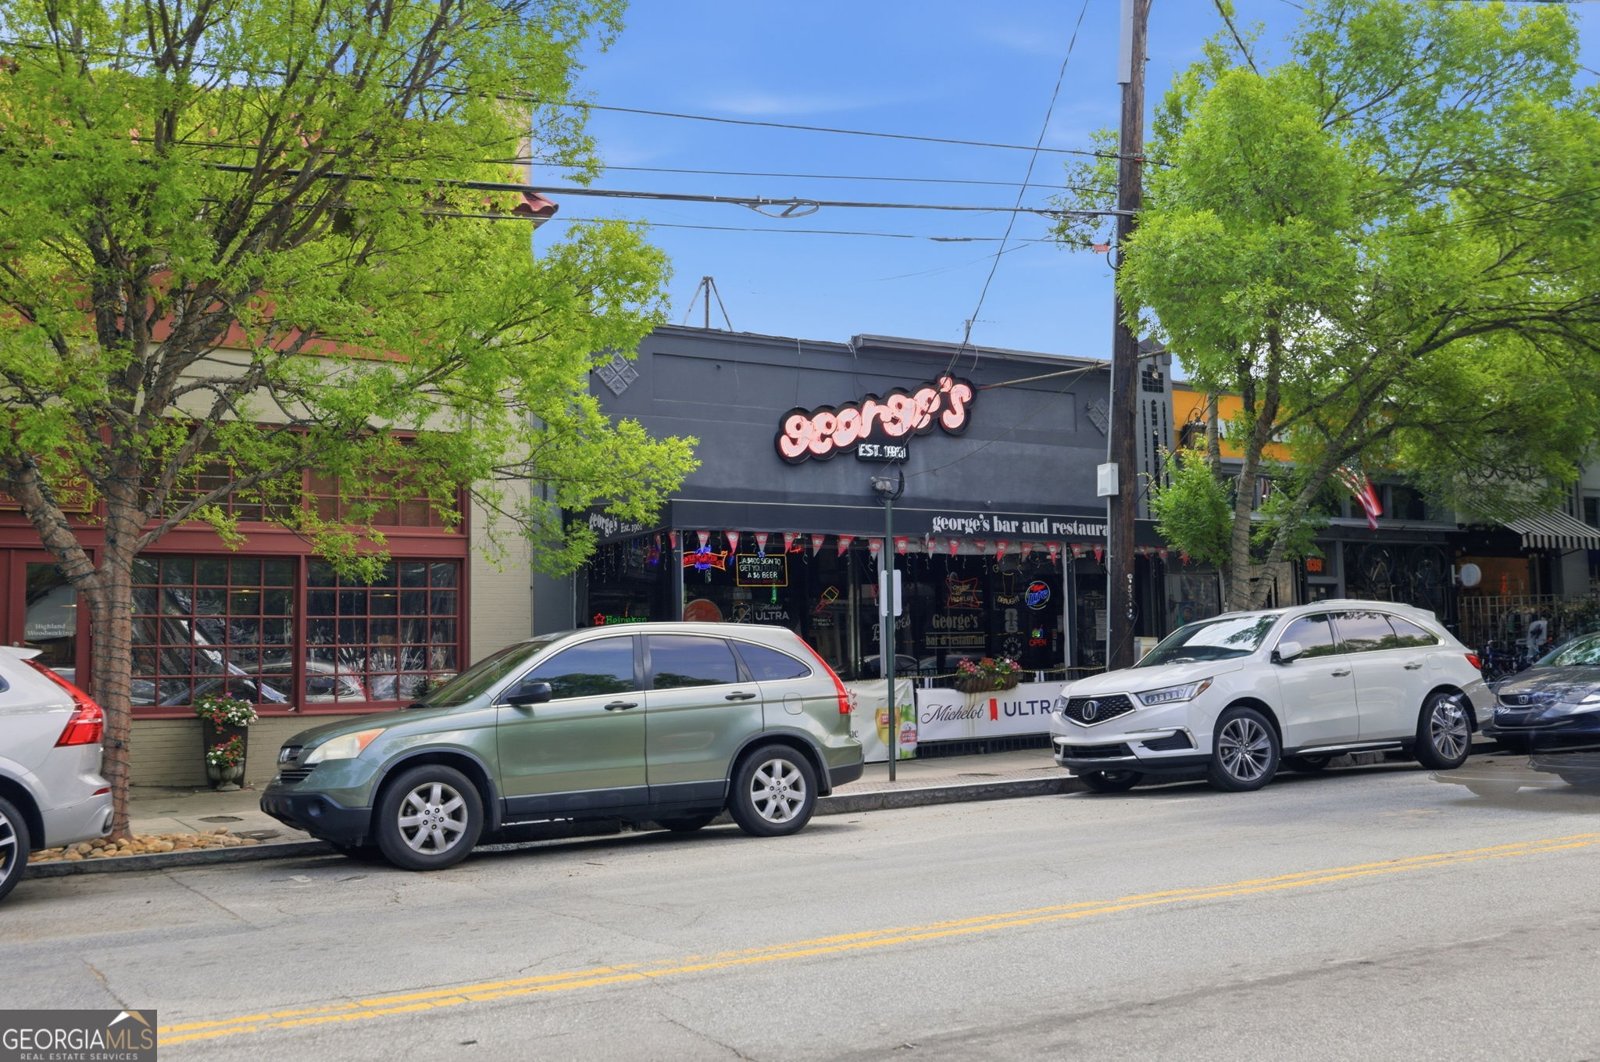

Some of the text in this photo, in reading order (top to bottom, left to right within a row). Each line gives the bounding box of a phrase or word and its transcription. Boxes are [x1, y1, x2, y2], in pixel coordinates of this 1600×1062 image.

[780, 377, 972, 458] george's
[858, 443, 883, 457] EST.
[932, 513, 990, 535] george's
[993, 515, 1019, 534] bar
[1021, 517, 1049, 534] and
[761, 571, 778, 579] BEER
[755, 611, 790, 621] ULTRA
[931, 613, 979, 631] George's
[1028, 639, 1047, 647] OPEN
[920, 699, 1058, 725] Michelob ULTR
